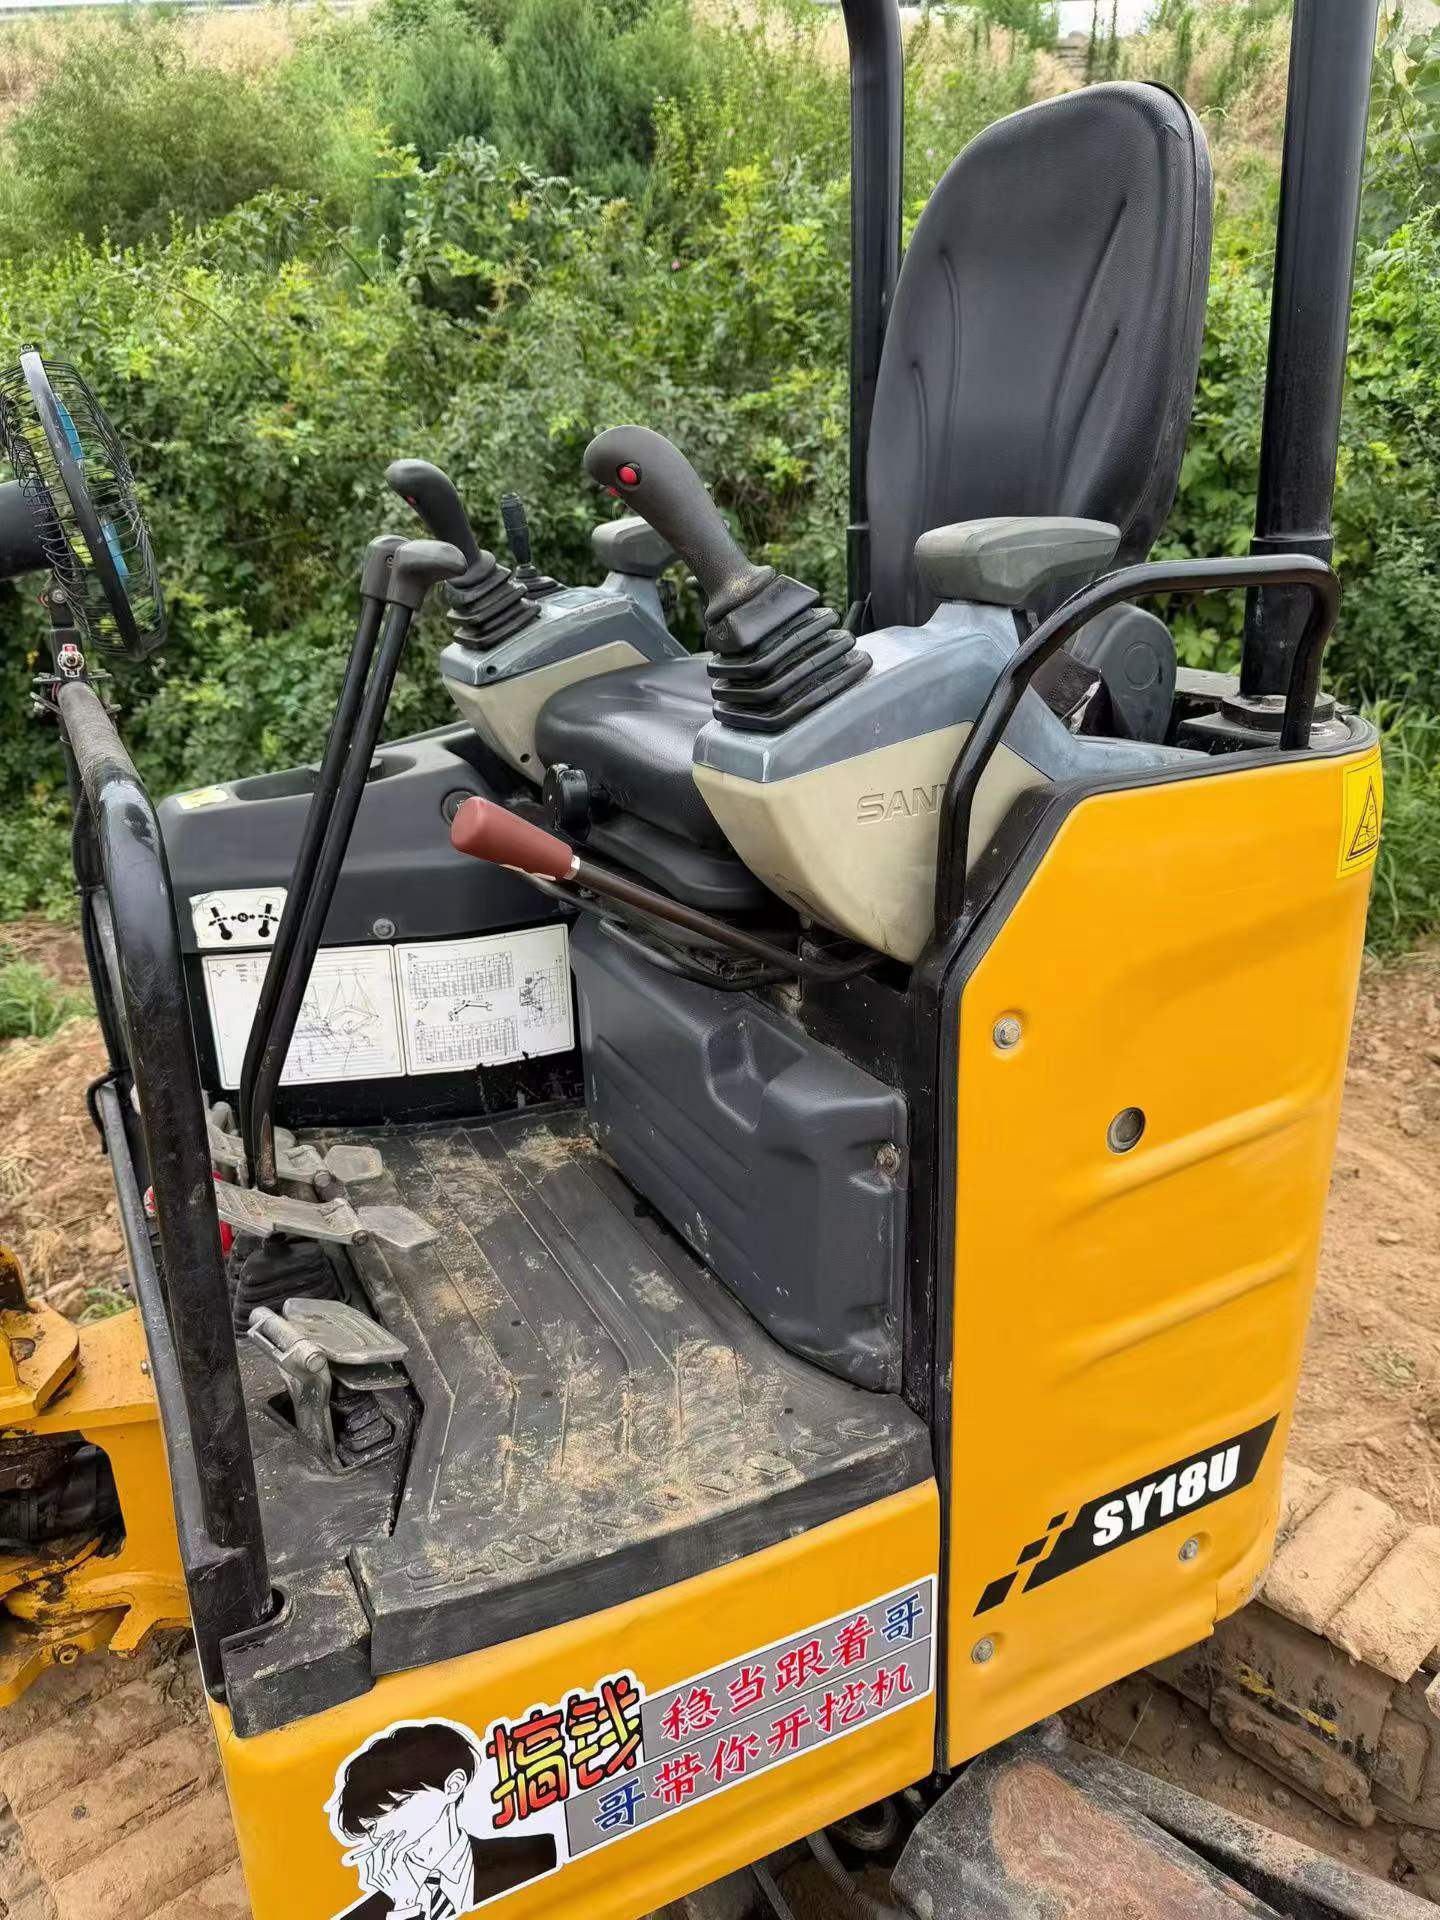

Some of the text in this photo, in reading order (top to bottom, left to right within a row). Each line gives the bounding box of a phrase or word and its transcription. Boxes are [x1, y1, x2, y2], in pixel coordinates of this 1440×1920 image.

[857, 783, 947, 825] SAN
[1092, 1445, 1240, 1546] SY18U
[659, 1593, 924, 1741] 稳当跟着哥
[486, 1675, 642, 1829] 搞钱
[593, 1661, 914, 1831] 哥带你开挖机
